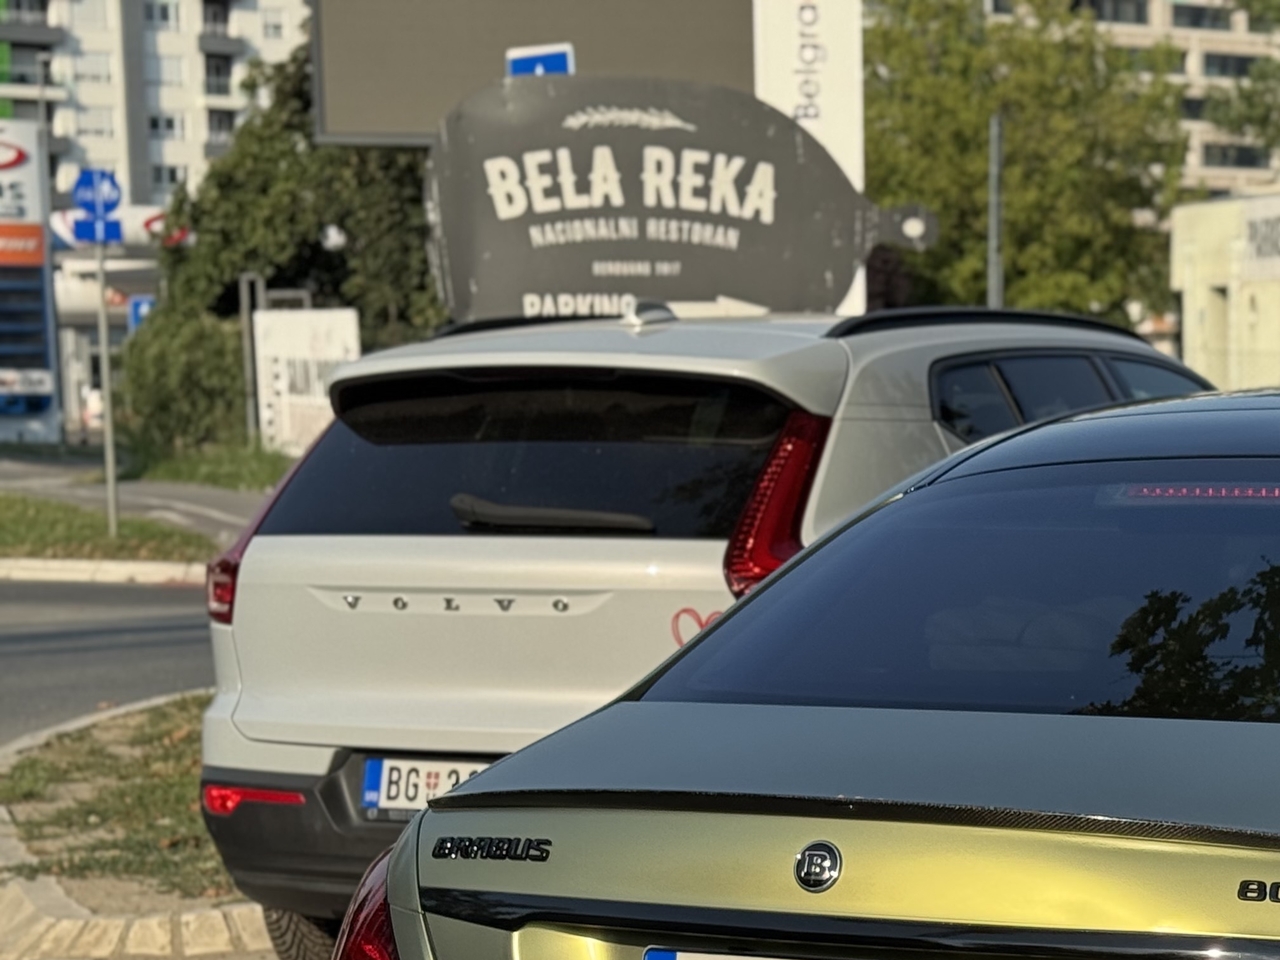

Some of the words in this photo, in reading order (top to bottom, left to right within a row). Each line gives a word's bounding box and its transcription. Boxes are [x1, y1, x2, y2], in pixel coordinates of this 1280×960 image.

[484, 145, 625, 221] BELA
[641, 145, 777, 225] REKA
[528, 216, 639, 249] NACIONALNI
[646, 217, 740, 250] RESTORAN
[343, 595, 570, 613] VOLVO
[386, 766, 420, 802] BG
[432, 837, 552, 862] BRABUS
